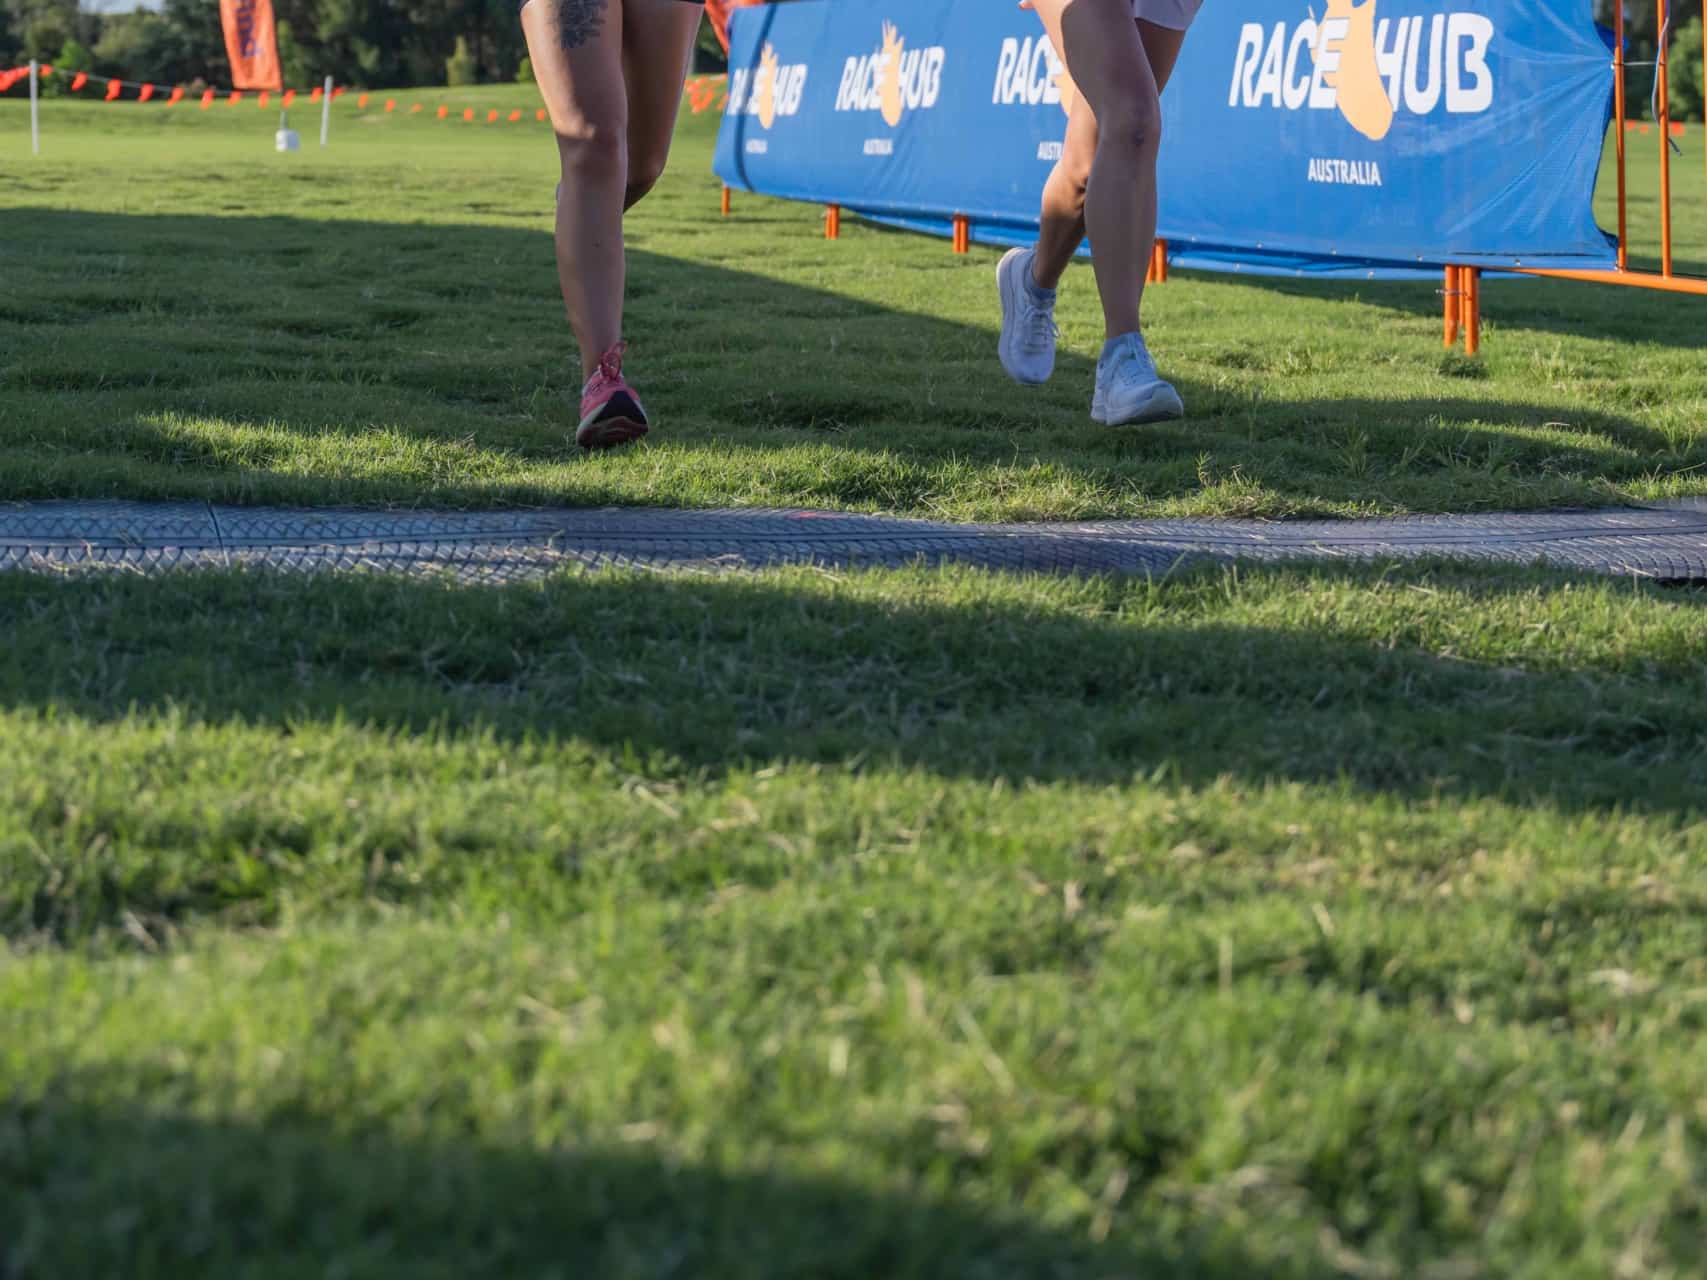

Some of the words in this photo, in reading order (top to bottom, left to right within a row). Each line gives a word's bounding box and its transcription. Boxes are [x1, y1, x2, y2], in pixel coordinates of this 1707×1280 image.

[834, 53, 892, 111] RACE
[898, 46, 945, 110] HUB
[992, 34, 1063, 105] RACE
[1228, 16, 1350, 110] RACE
[1374, 12, 1494, 115] HUB
[1307, 158, 1382, 186] AUSTRALIA
